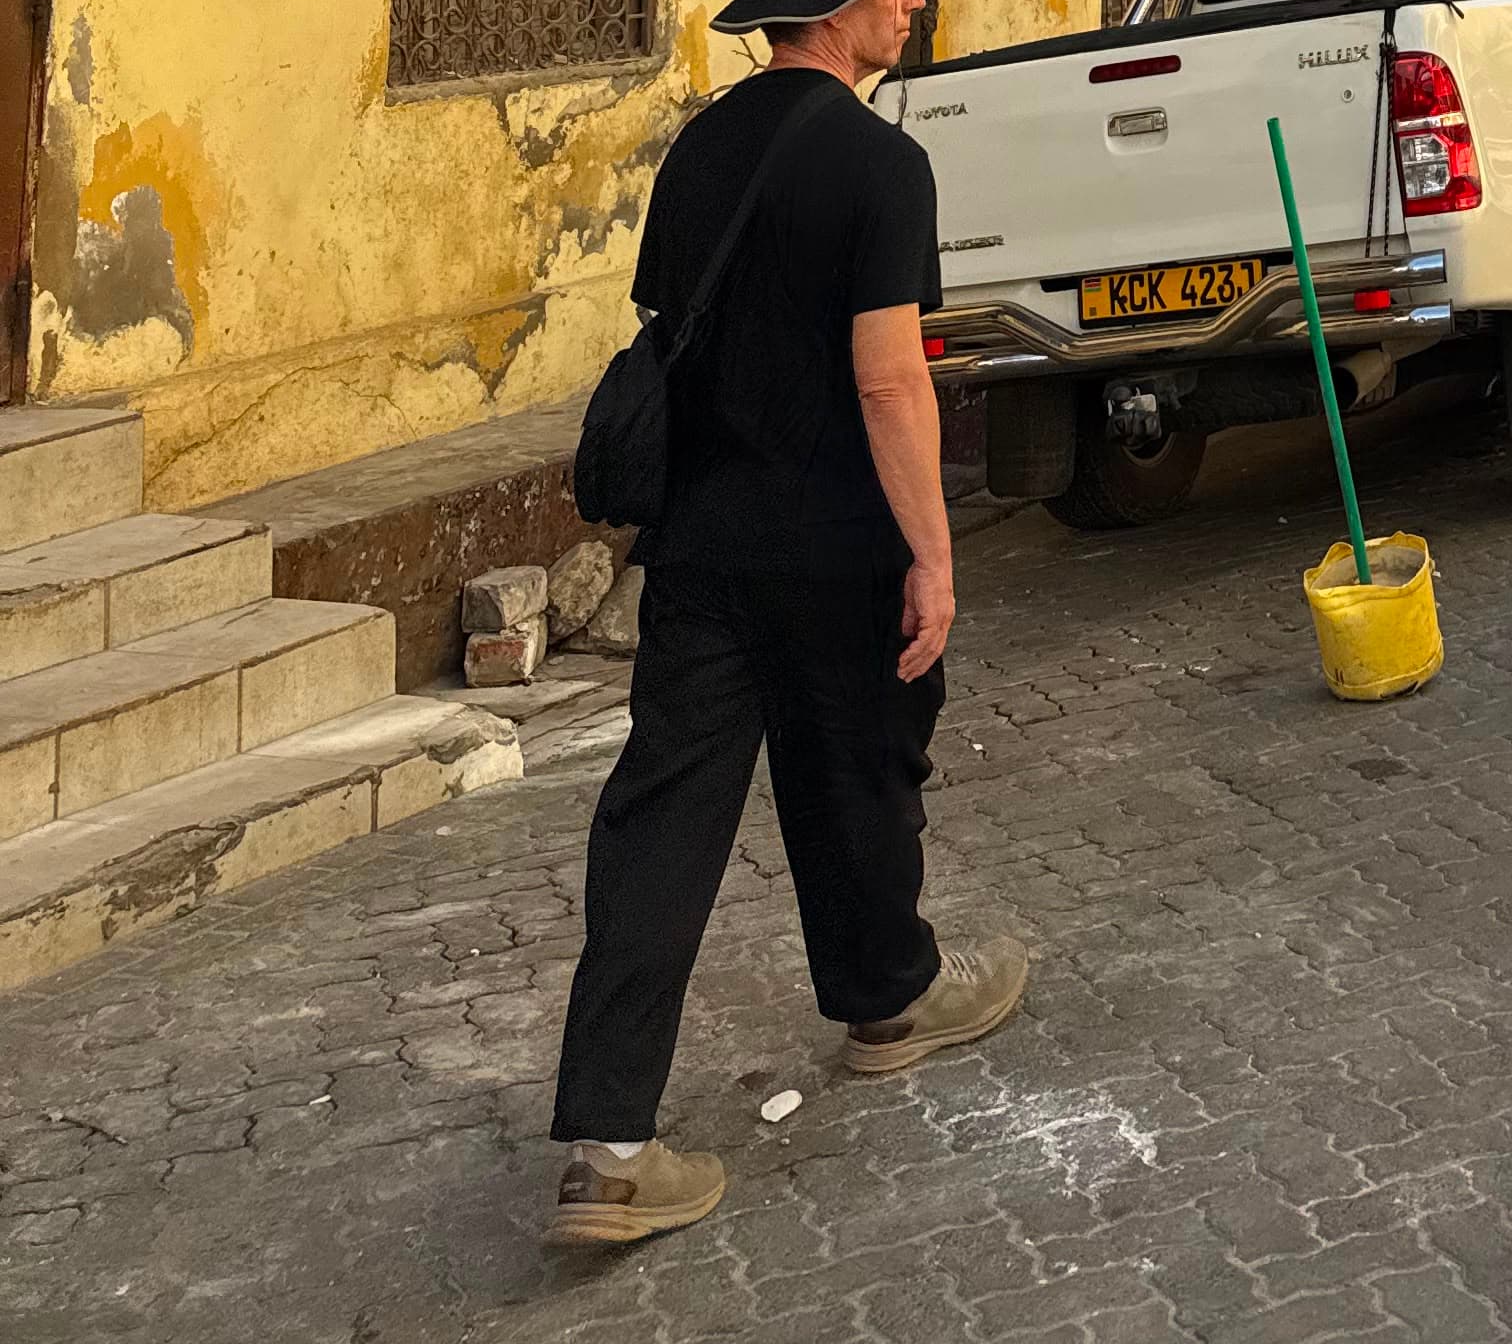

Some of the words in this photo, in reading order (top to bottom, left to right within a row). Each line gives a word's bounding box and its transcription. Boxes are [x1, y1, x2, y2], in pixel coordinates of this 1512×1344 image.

[1298, 44, 1370, 69] HILUX
[914, 102, 968, 122] TOYOTA
[1108, 270, 1167, 316] KCK
[1180, 262, 1255, 307] 423J
